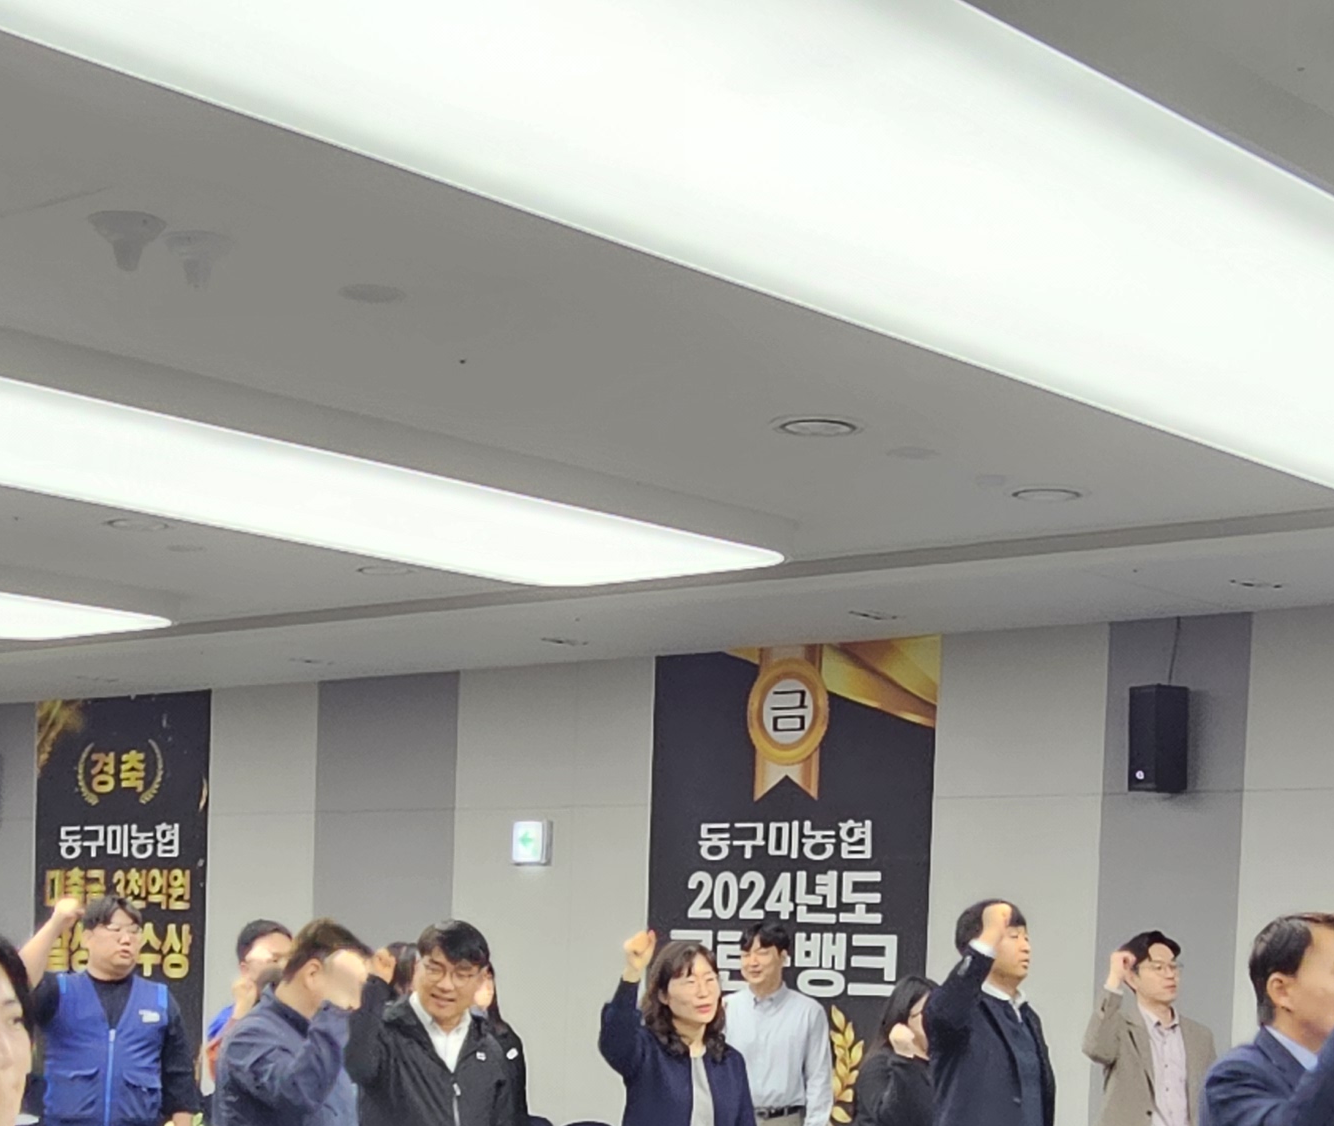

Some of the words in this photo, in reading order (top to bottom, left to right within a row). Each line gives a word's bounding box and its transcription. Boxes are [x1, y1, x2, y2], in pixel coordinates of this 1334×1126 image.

[770, 689, 808, 732] 금
[58, 821, 180, 860] 동구미농협
[697, 818, 872, 861] 동구미농협
[687, 870, 883, 924] 2024년도
